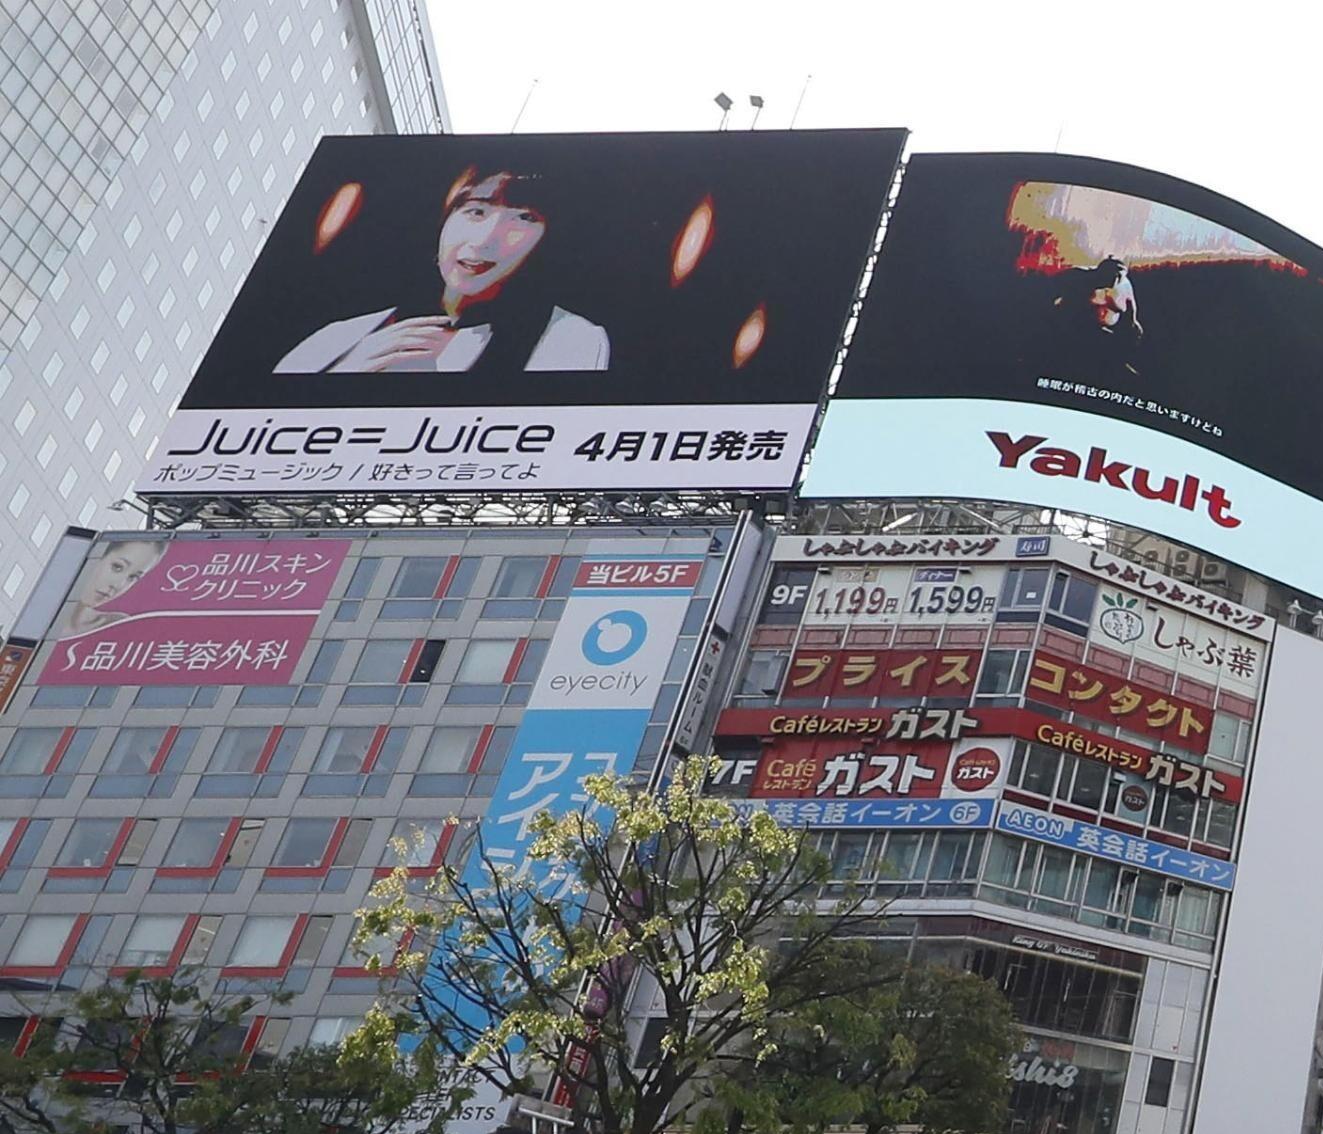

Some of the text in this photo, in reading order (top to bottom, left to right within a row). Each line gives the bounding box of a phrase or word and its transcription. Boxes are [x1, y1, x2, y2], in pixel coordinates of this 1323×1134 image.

[168, 416, 556, 457] Juice=Juice
[573, 429, 788, 463] 4月1日発売
[154, 462, 341, 483] ポップミュージック
[368, 462, 541, 483] 好きって言ってよ
[984, 428, 1243, 529] Yakult
[803, 536, 1000, 558] しゃぶしゃぶバイキング
[202, 552, 332, 575] 品川スキン
[586, 564, 690, 586] 当ビル5F
[190, 578, 307, 601] クリニック
[770, 584, 809, 606] 9F
[815, 585, 899, 620] 1,199円
[910, 584, 996, 619] 1,599円
[1090, 550, 1266, 630] しゃぶしゃぶバイキング
[80, 638, 290, 672] 品川美容外科
[1153, 616, 1258, 679] しゃぶ葉
[550, 671, 649, 698] eyecity
[792, 654, 971, 687] プライス
[1029, 658, 1205, 738] コンタクト
[885, 708, 979, 740] ガスト
[711, 759, 758, 785] 7F
[766, 758, 817, 778] Café
[816, 752, 935, 795] ガスト
[956, 766, 995, 780] ガスト
[1145, 753, 1226, 798] ガスト
[774, 801, 942, 824] 英会話イーオン
[1008, 810, 1065, 837] AEON
[1076, 825, 1232, 882] 英会話イーオン
